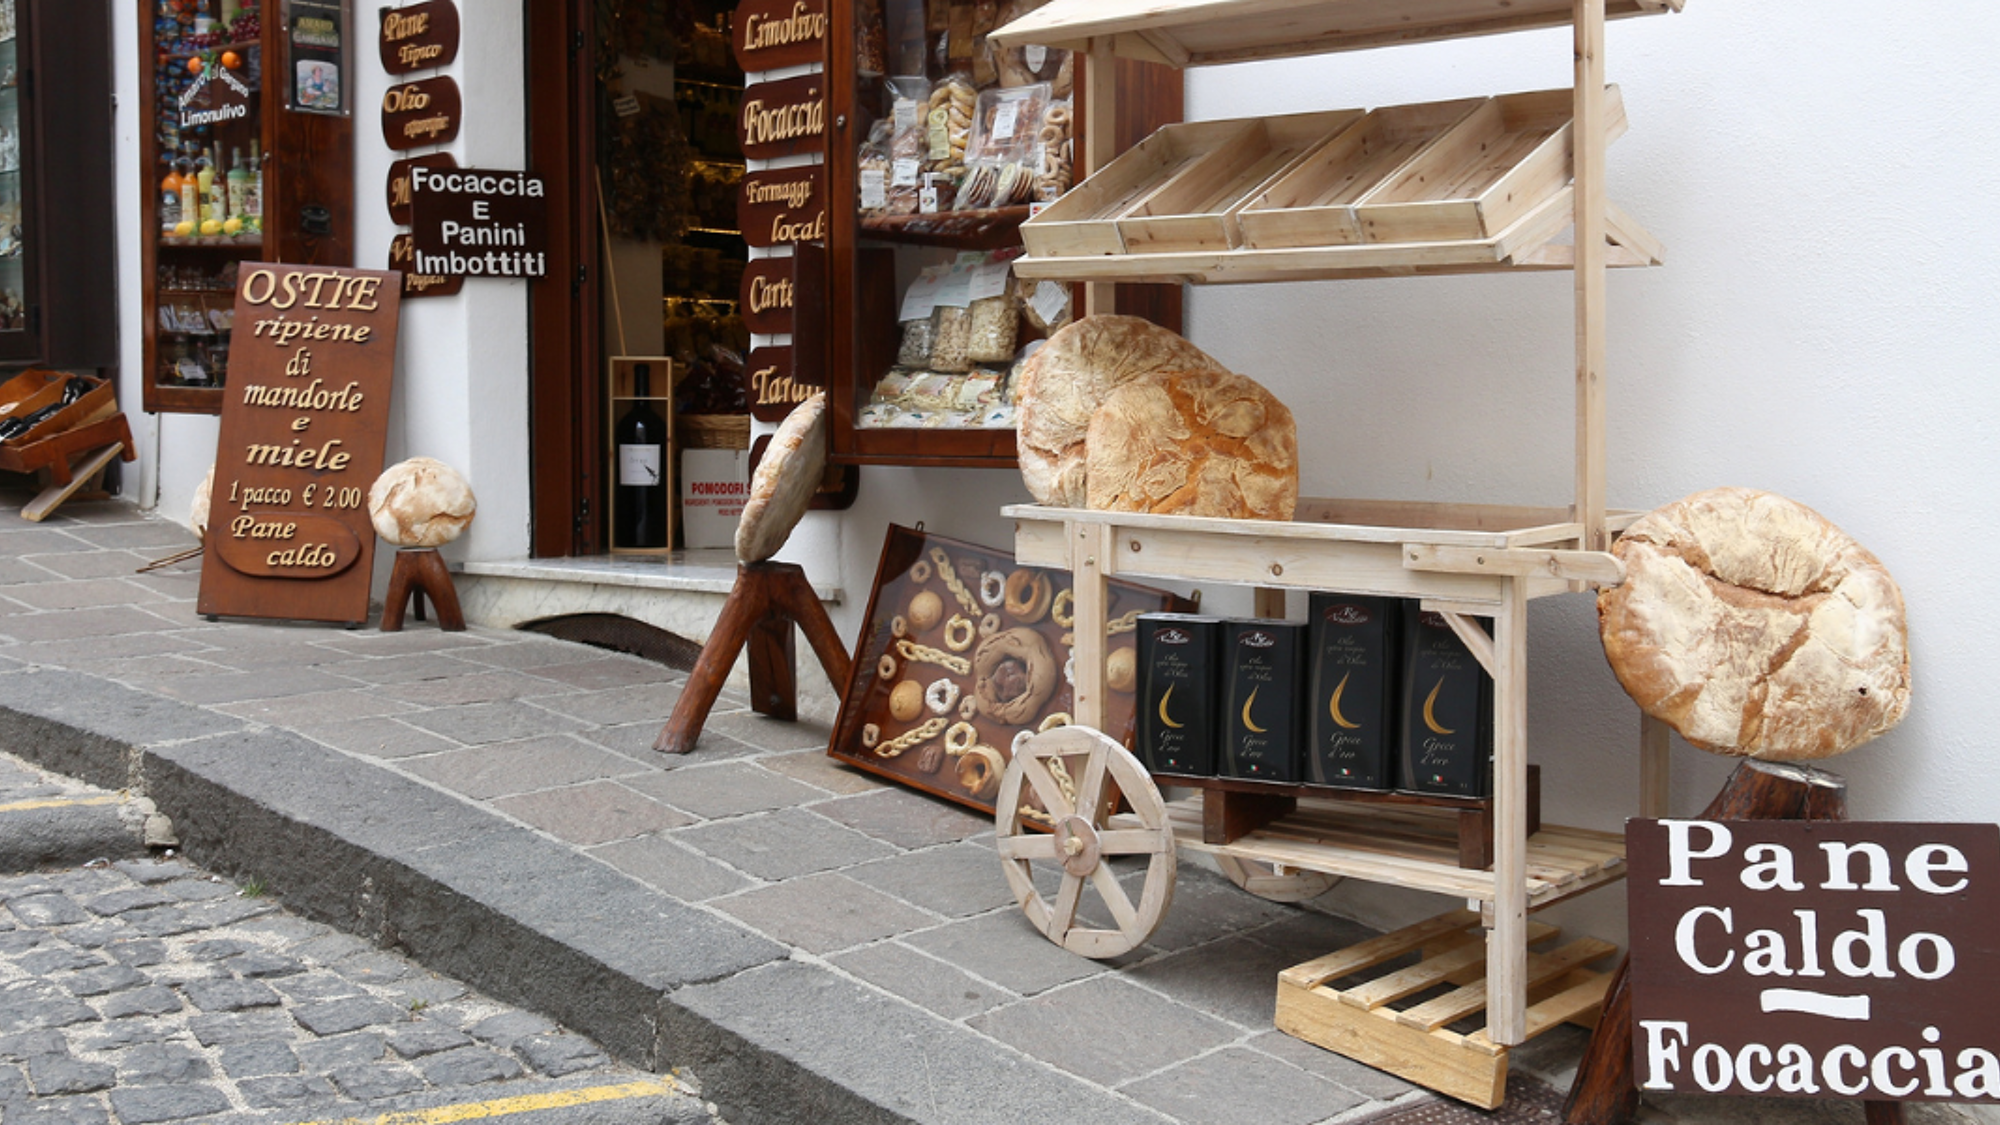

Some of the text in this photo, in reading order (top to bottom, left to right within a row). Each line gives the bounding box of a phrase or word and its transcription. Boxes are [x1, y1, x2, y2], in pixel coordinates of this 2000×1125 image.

[384, 12, 429, 42] Pane
[743, 1, 824, 51] Limolivo
[398, 43, 443, 68] Tipico
[384, 84, 430, 113] Olio
[181, 103, 246, 127] Limonulivo
[744, 88, 824, 145] Focaccia
[412, 167, 544, 197] Focaccia
[746, 174, 814, 208] Formaggi
[472, 201, 490, 220] E
[441, 220, 525, 246] Panini
[415, 249, 545, 276] Imbottiti
[242, 269, 382, 311] OSTIE
[254, 316, 371, 345] ripiene
[285, 347, 310, 376] di
[243, 379, 364, 412] mandorle
[291, 416, 310, 431] e
[246, 440, 351, 471] miele
[229, 480, 239, 502] 1
[241, 487, 292, 511] pacco
[323, 487, 362, 509] 2.00
[692, 482, 744, 495] POMODORI
[231, 515, 297, 538] Pane
[266, 543, 336, 568] caldo
[1658, 819, 1969, 894] Pane
[1675, 905, 1956, 980] Caldo
[1639, 1019, 2000, 1098] Focaccia
